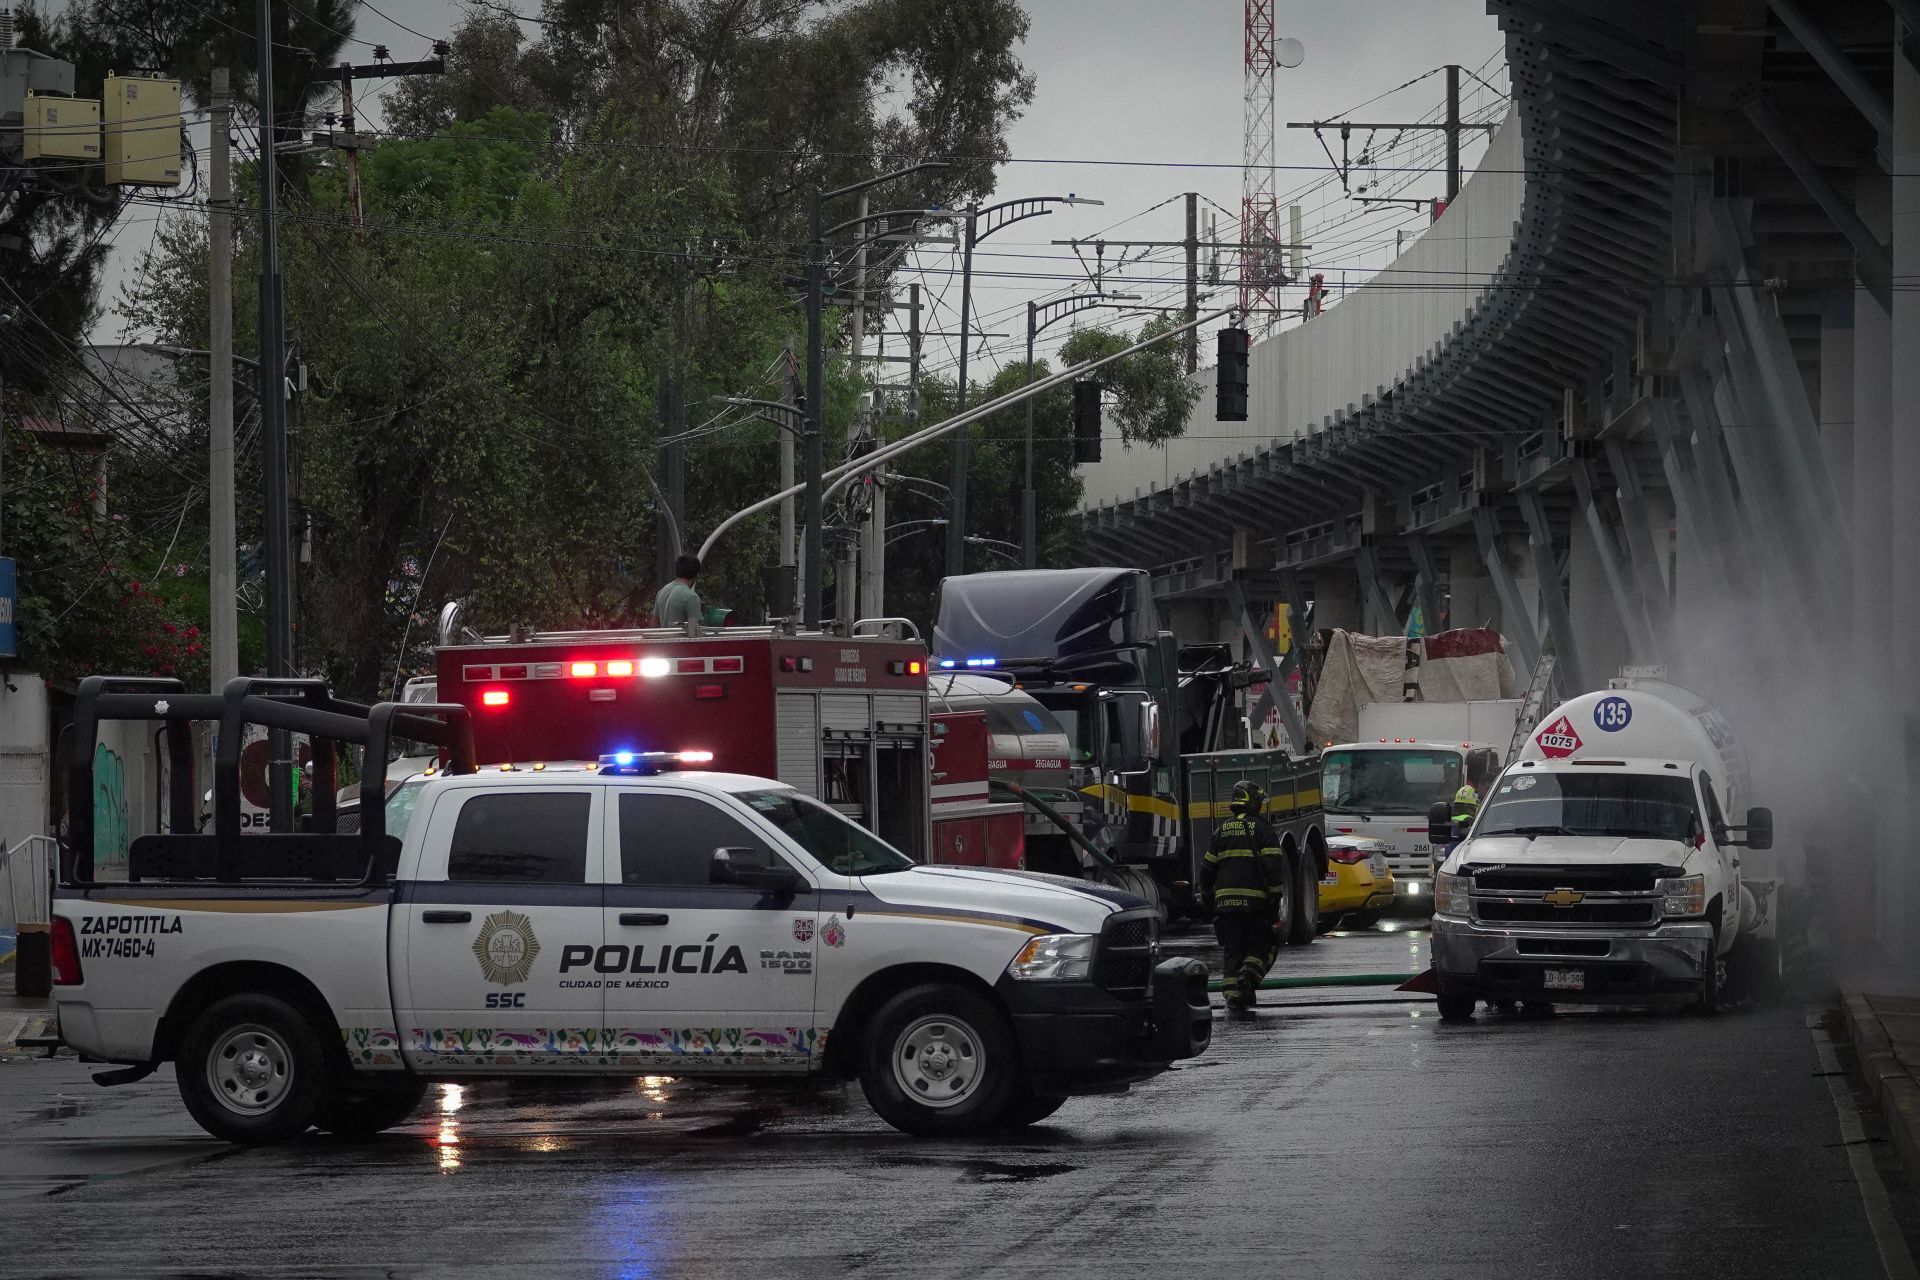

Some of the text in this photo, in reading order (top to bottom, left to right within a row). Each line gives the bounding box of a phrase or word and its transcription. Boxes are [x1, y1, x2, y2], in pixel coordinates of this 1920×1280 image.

[1597, 702, 1627, 725] 135
[1544, 735, 1573, 748] 1075
[1035, 760, 1062, 769] SEGIAGUA
[1414, 844, 1430, 852] 2861
[80, 915, 183, 935] ZAPOTITLA
[559, 933, 748, 974] POLICÍA
[760, 950, 812, 959] RAM
[760, 960, 812, 969] 1500
[559, 977, 670, 989] CIUDAD DE MÉXICO
[485, 993, 526, 1008] SSC
